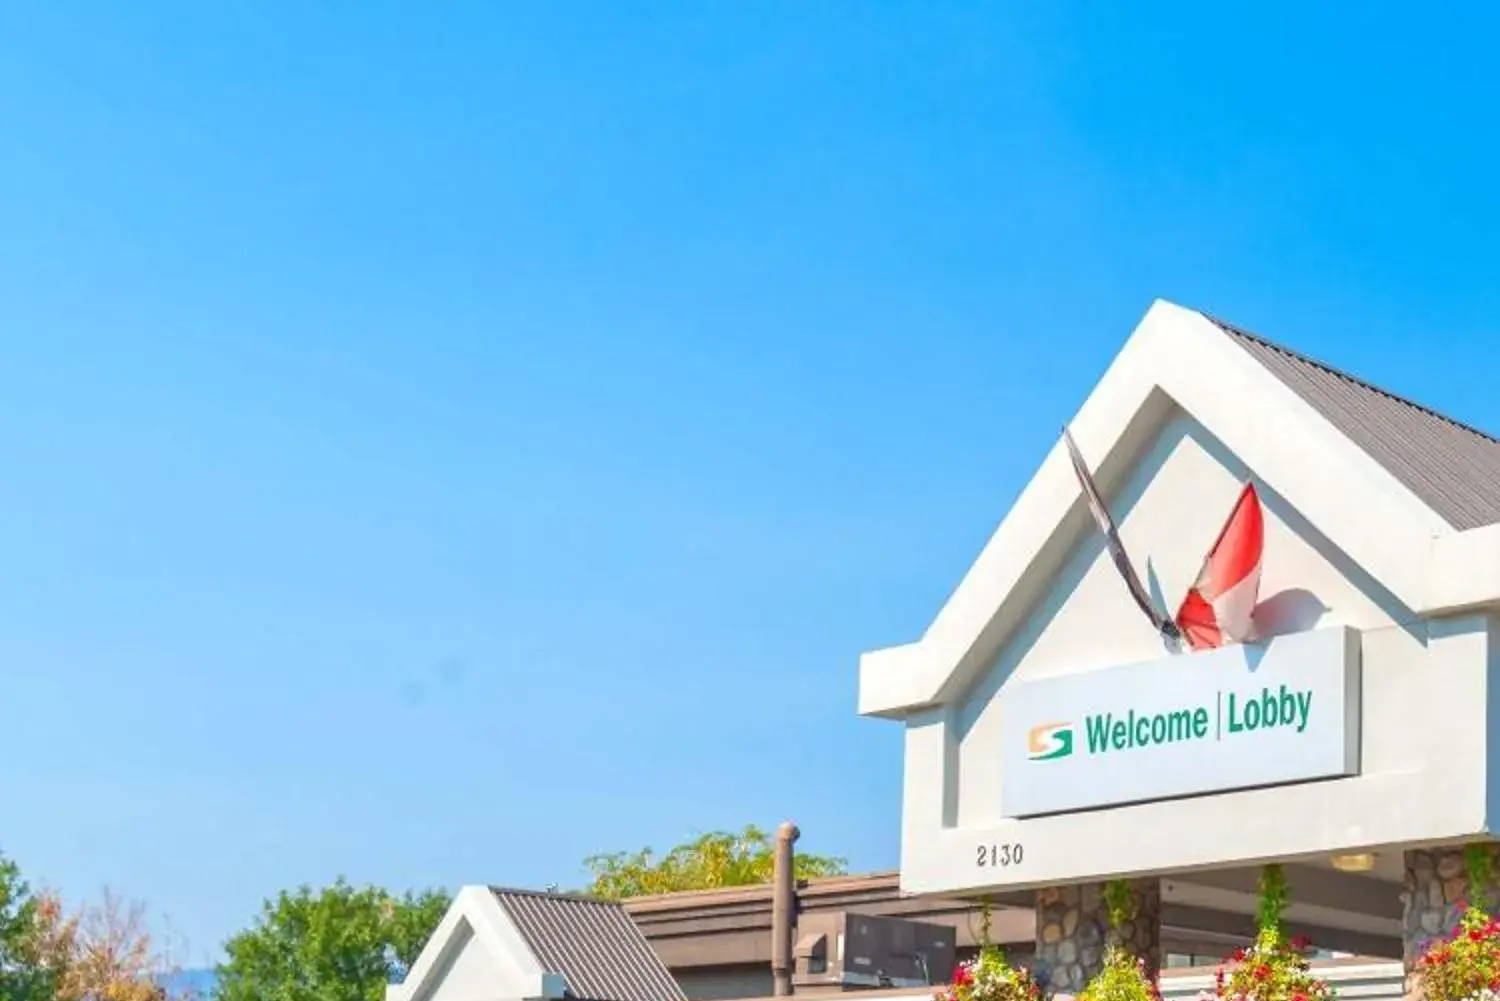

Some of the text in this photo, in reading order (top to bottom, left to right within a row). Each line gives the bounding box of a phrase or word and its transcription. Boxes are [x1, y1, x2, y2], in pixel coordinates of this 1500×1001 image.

[1085, 686, 1311, 754] Welcome Lobby
[976, 842, 1024, 867] 2130
